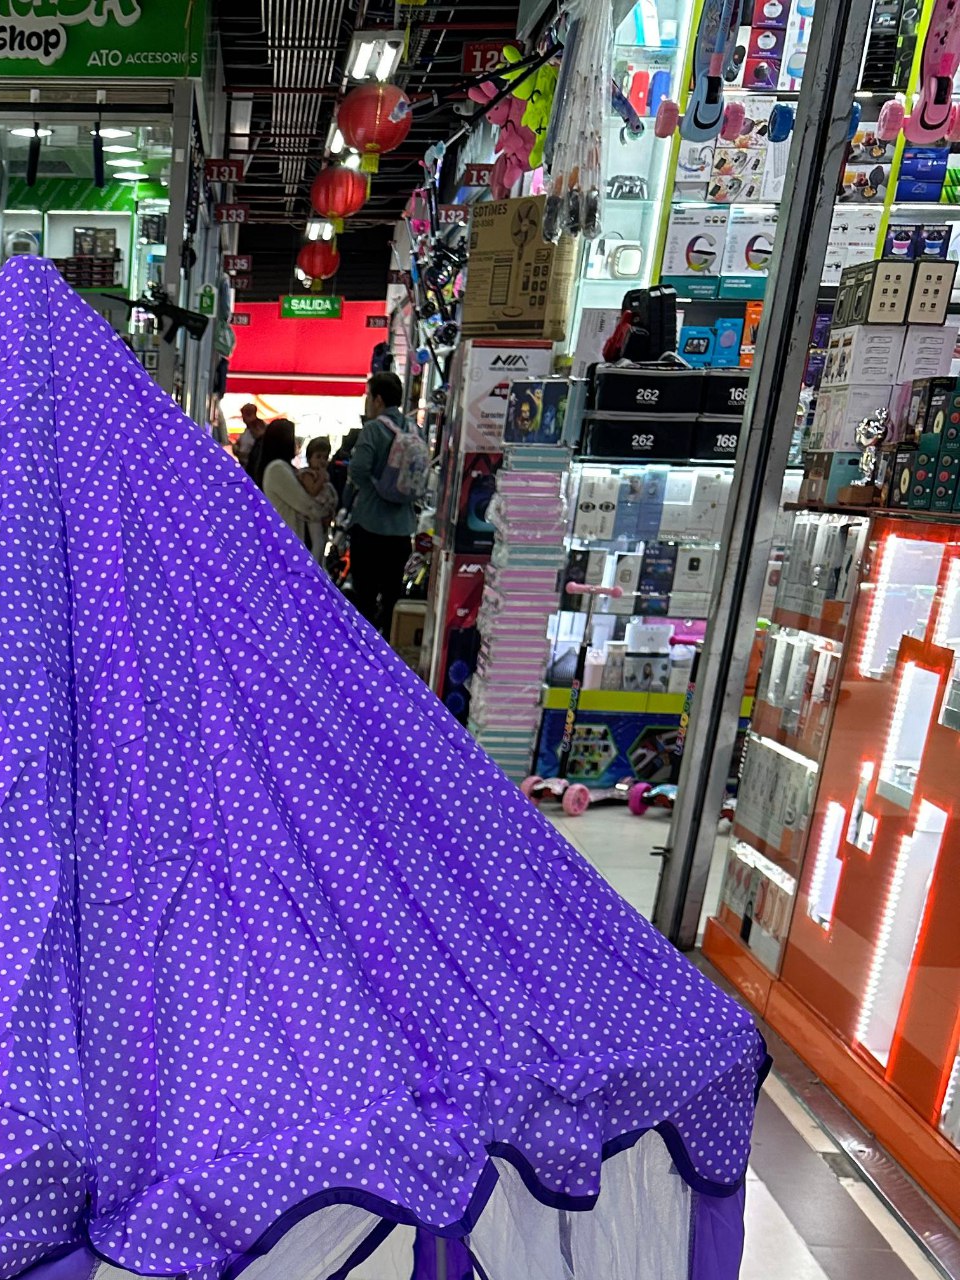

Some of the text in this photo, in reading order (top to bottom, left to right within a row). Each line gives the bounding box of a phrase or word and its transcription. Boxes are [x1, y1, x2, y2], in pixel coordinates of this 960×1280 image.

[87, 49, 122, 66] ATO
[211, 166, 238, 181] 131
[221, 209, 245, 223] 133
[439, 210, 465, 223] 132
[228, 259, 248, 270] 135
[290, 299, 332, 311] SALIDA
[636, 388, 659, 400] 262
[729, 387, 748, 400] 168
[631, 434, 655, 446] 262
[716, 434, 737, 447] 168
